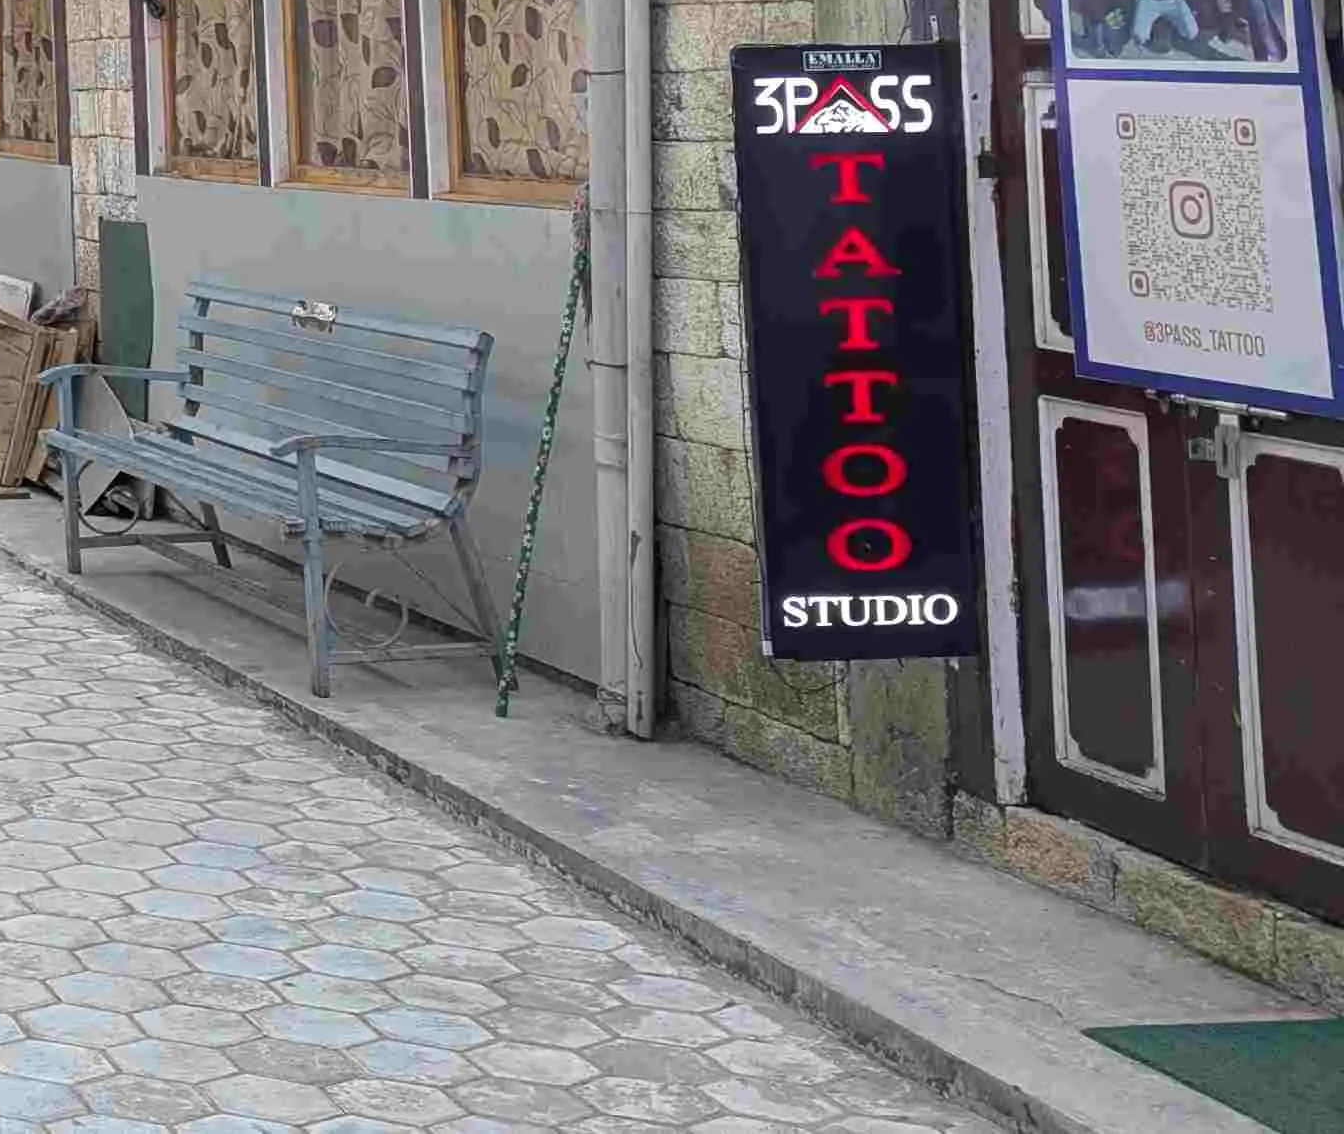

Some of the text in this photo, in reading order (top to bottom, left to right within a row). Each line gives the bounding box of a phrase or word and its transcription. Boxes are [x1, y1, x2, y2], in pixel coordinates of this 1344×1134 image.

[1143, 321, 1266, 357] @3PASS_TATTOO
[808, 152, 912, 572] TATTOO
[782, 593, 958, 628] STUDIO
